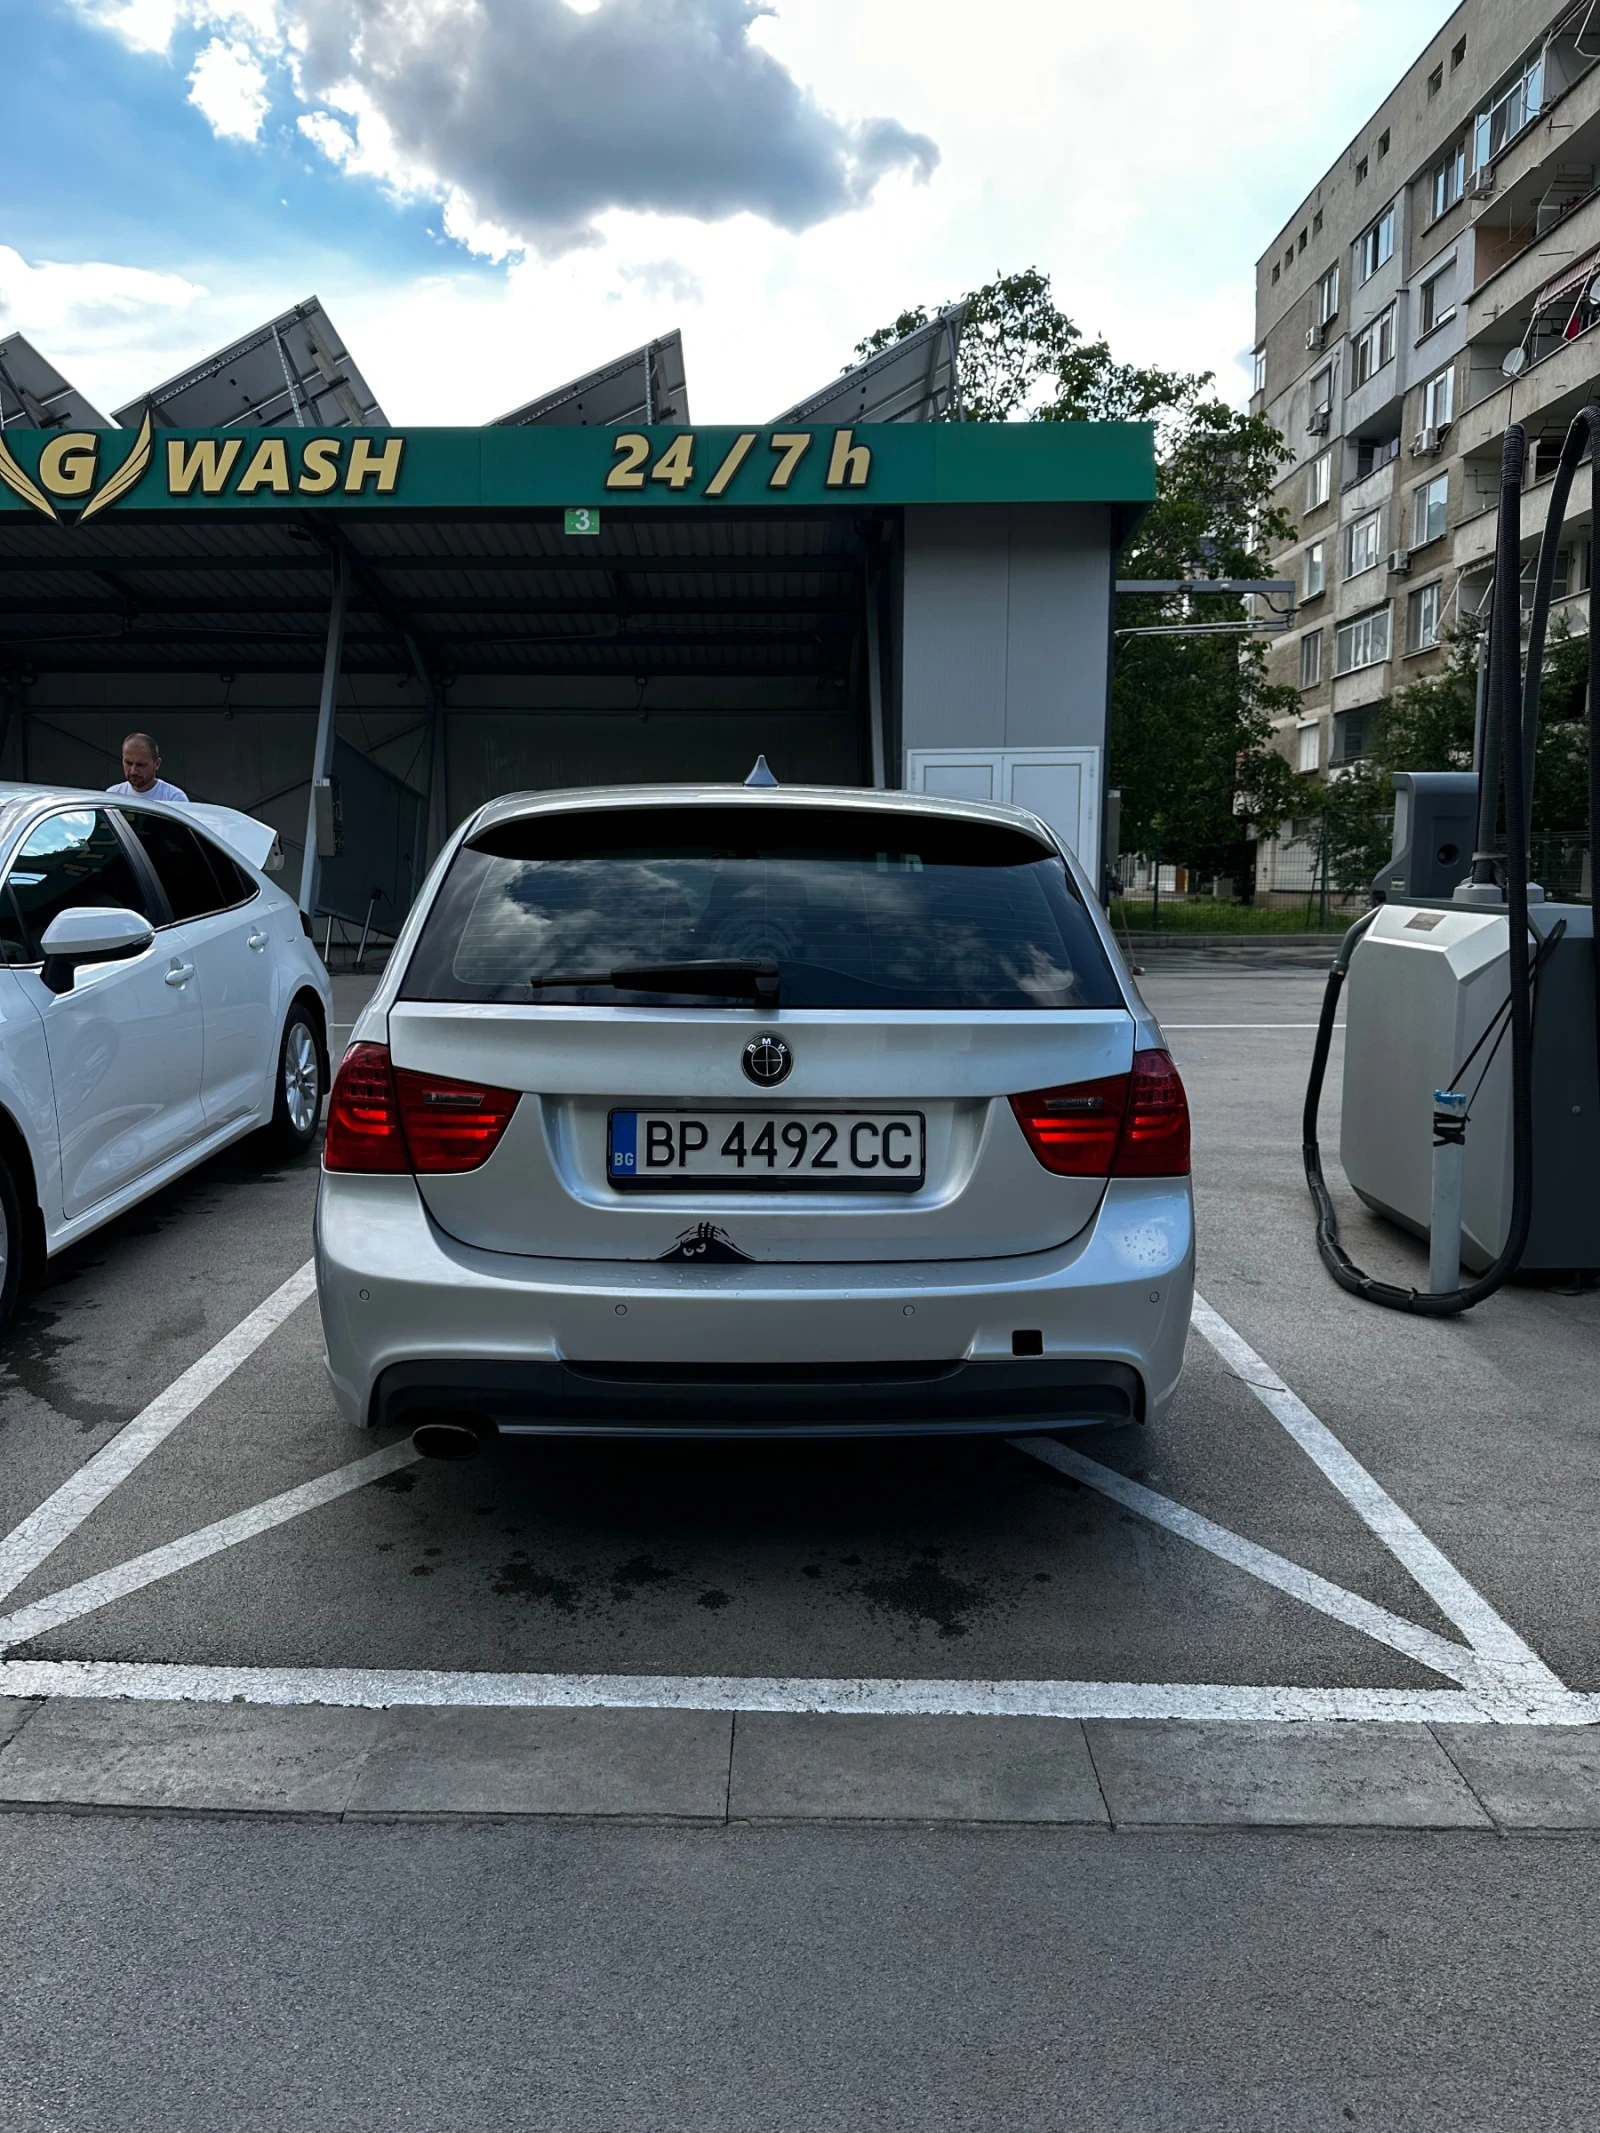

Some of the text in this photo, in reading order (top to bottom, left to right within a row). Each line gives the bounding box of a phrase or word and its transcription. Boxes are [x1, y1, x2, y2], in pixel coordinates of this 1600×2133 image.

[38, 431, 405, 496] G WASH
[575, 508, 590, 531] 3
[747, 1037, 788, 1053] BMW
[646, 1120, 912, 1168] BP 4492 CC
[614, 1152, 634, 1166] BG
